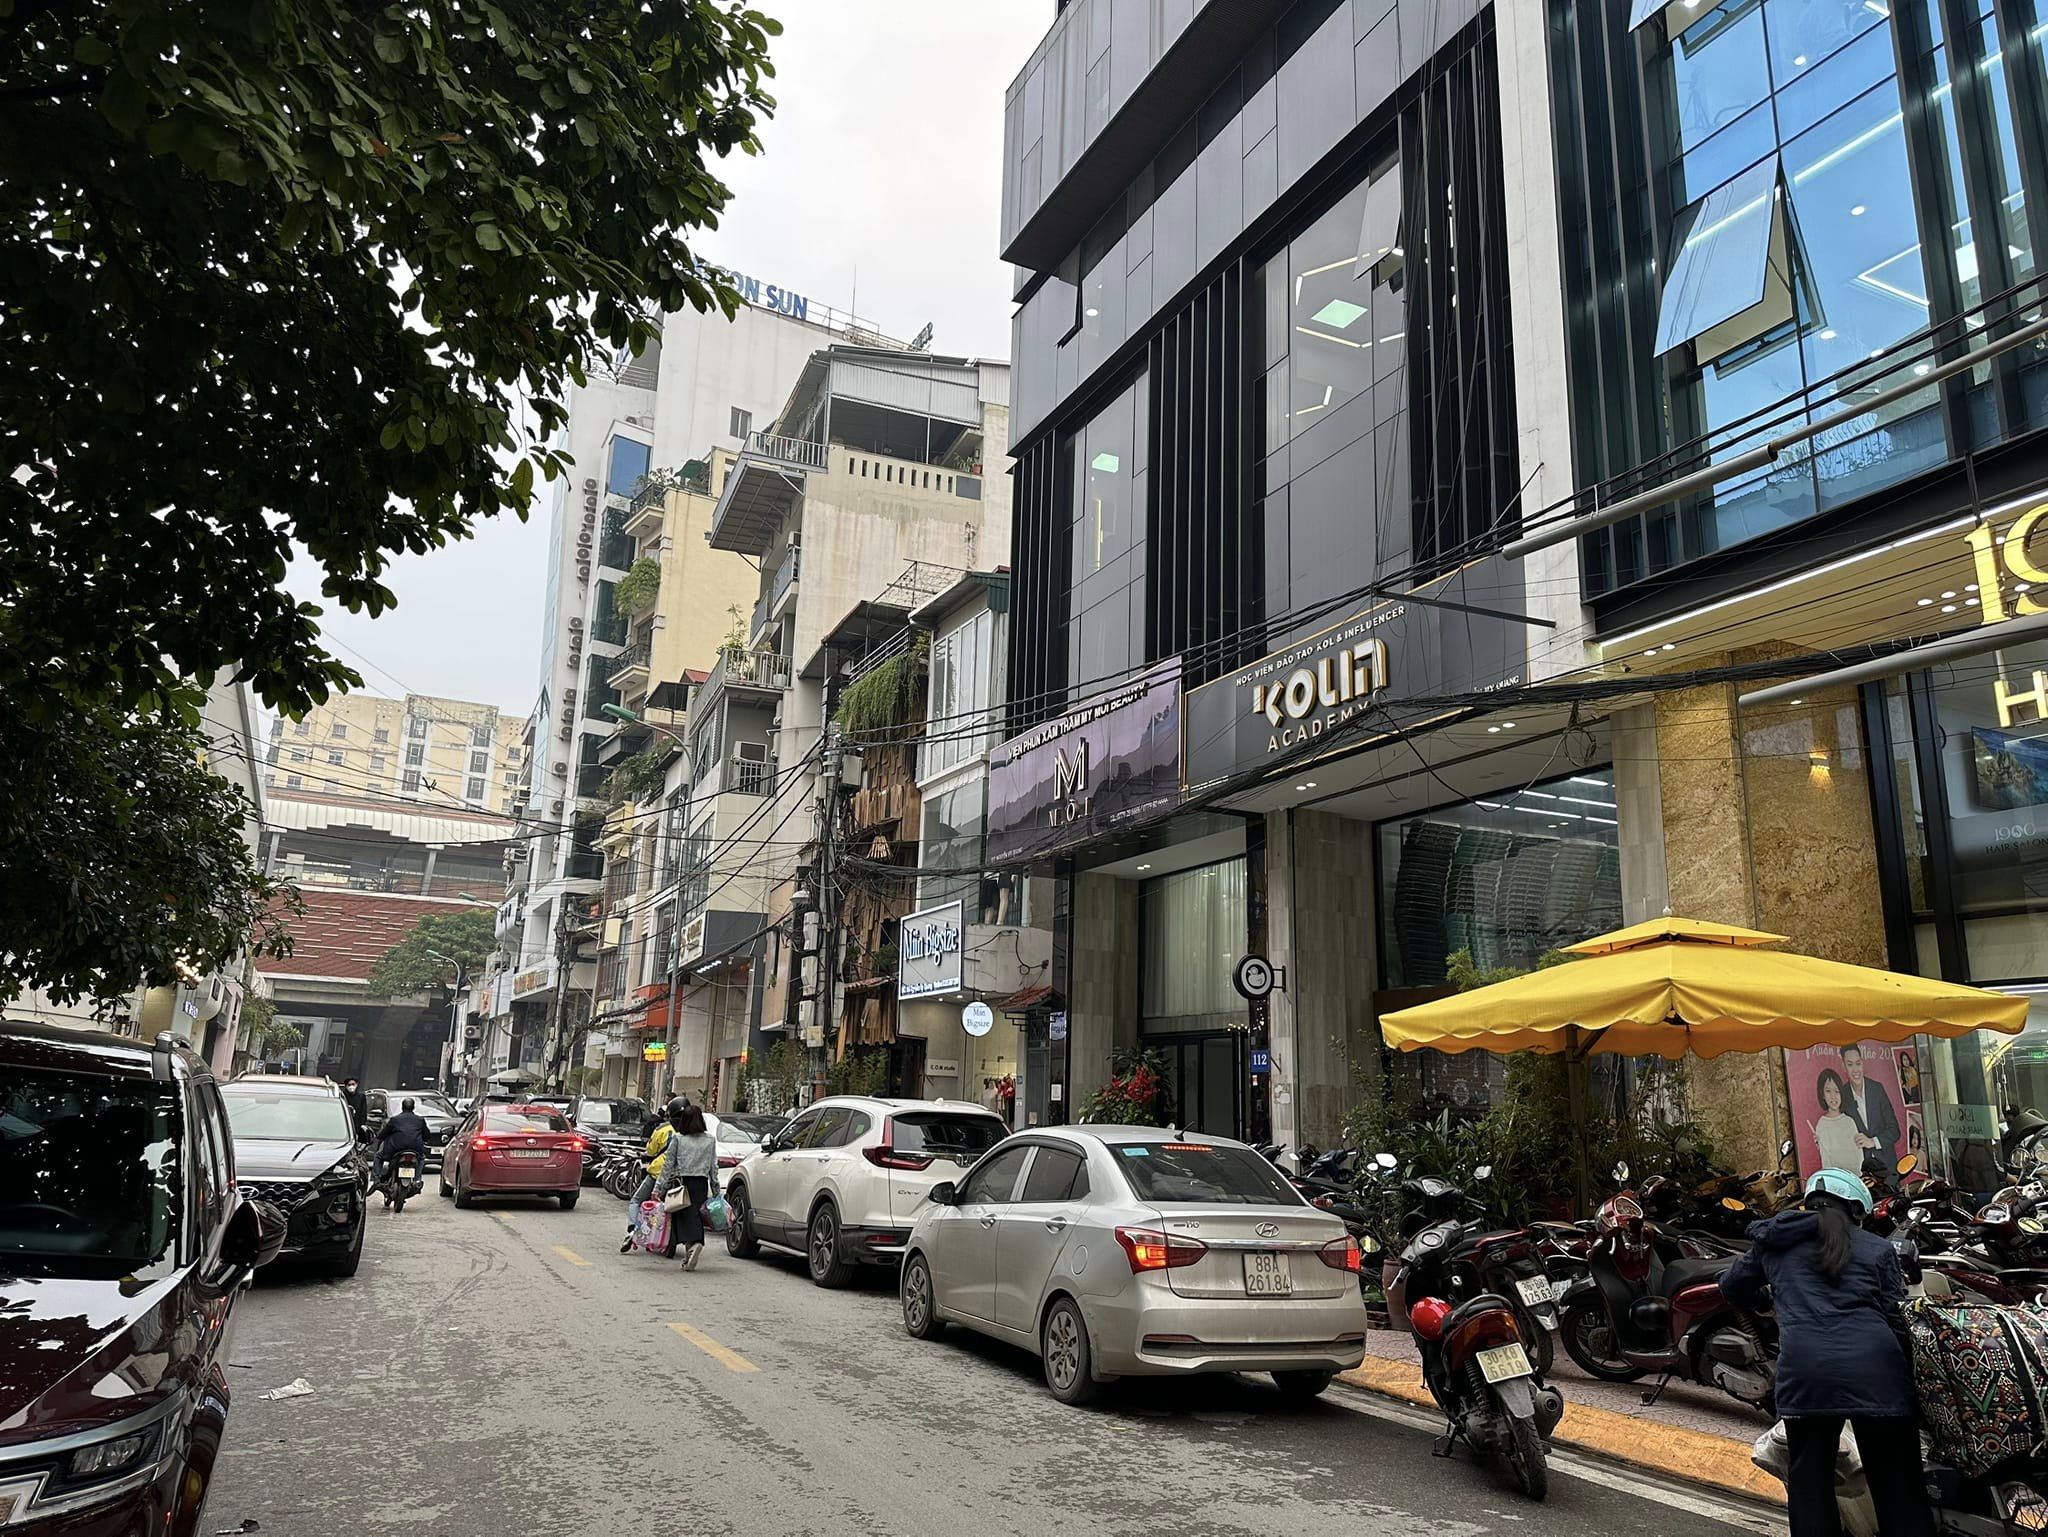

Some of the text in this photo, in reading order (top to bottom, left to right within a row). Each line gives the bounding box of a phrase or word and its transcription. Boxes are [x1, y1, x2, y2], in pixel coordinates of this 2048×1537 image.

[766, 285, 807, 320] SUN
[1316, 639, 1334, 652] KOL
[1344, 605, 1405, 639] INFLUENCER
[1985, 843, 2010, 854] HAIR
[925, 922, 958, 966] Bigsize
[1253, 1054, 1267, 1065] 112
[1255, 1256, 1279, 1272] 88A
[1248, 1274, 1290, 1292] 261.84
